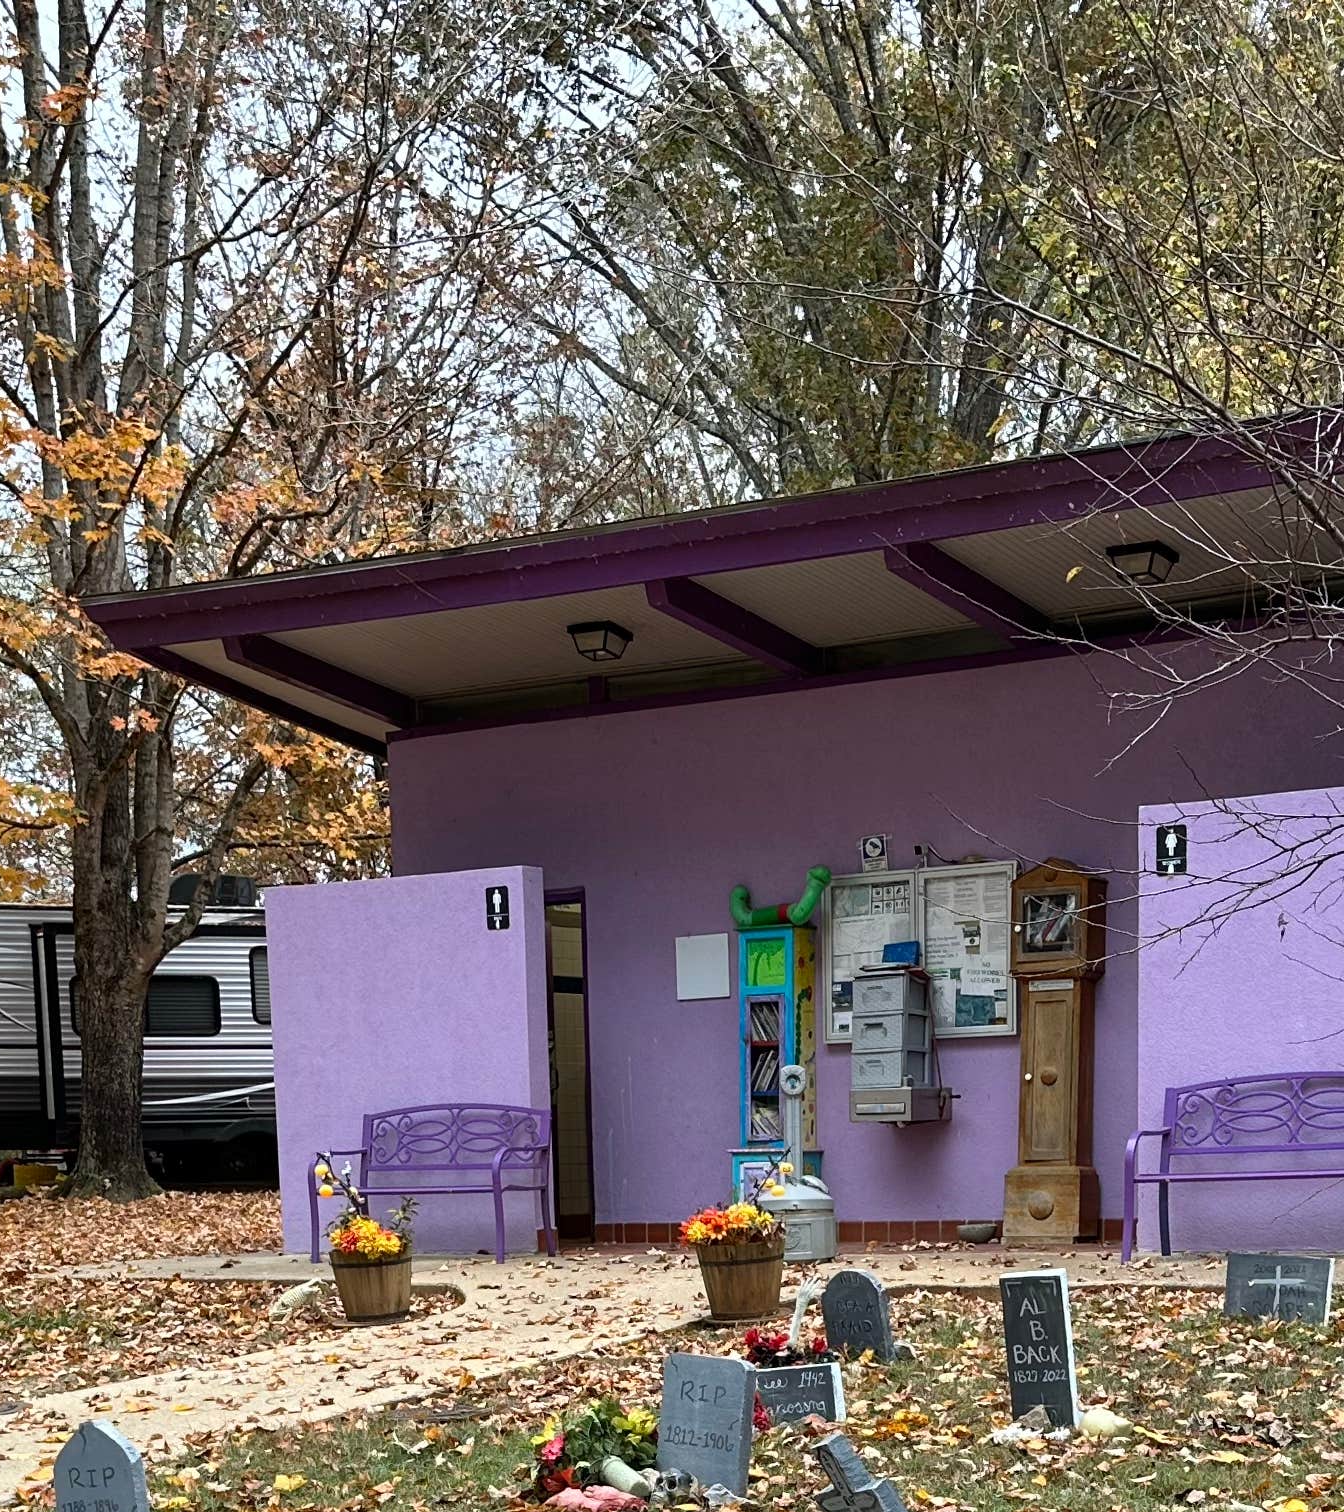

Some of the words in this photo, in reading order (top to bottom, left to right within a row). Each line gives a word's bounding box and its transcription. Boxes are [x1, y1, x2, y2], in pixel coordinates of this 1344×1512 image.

[1019, 1297, 1047, 1318] AL
[1029, 1320, 1048, 1341] B.
[1013, 1344, 1063, 1365] BACK
[680, 1380, 727, 1405] RIP
[664, 1424, 735, 1452] 1812-1906
[68, 1466, 116, 1489] RIP
